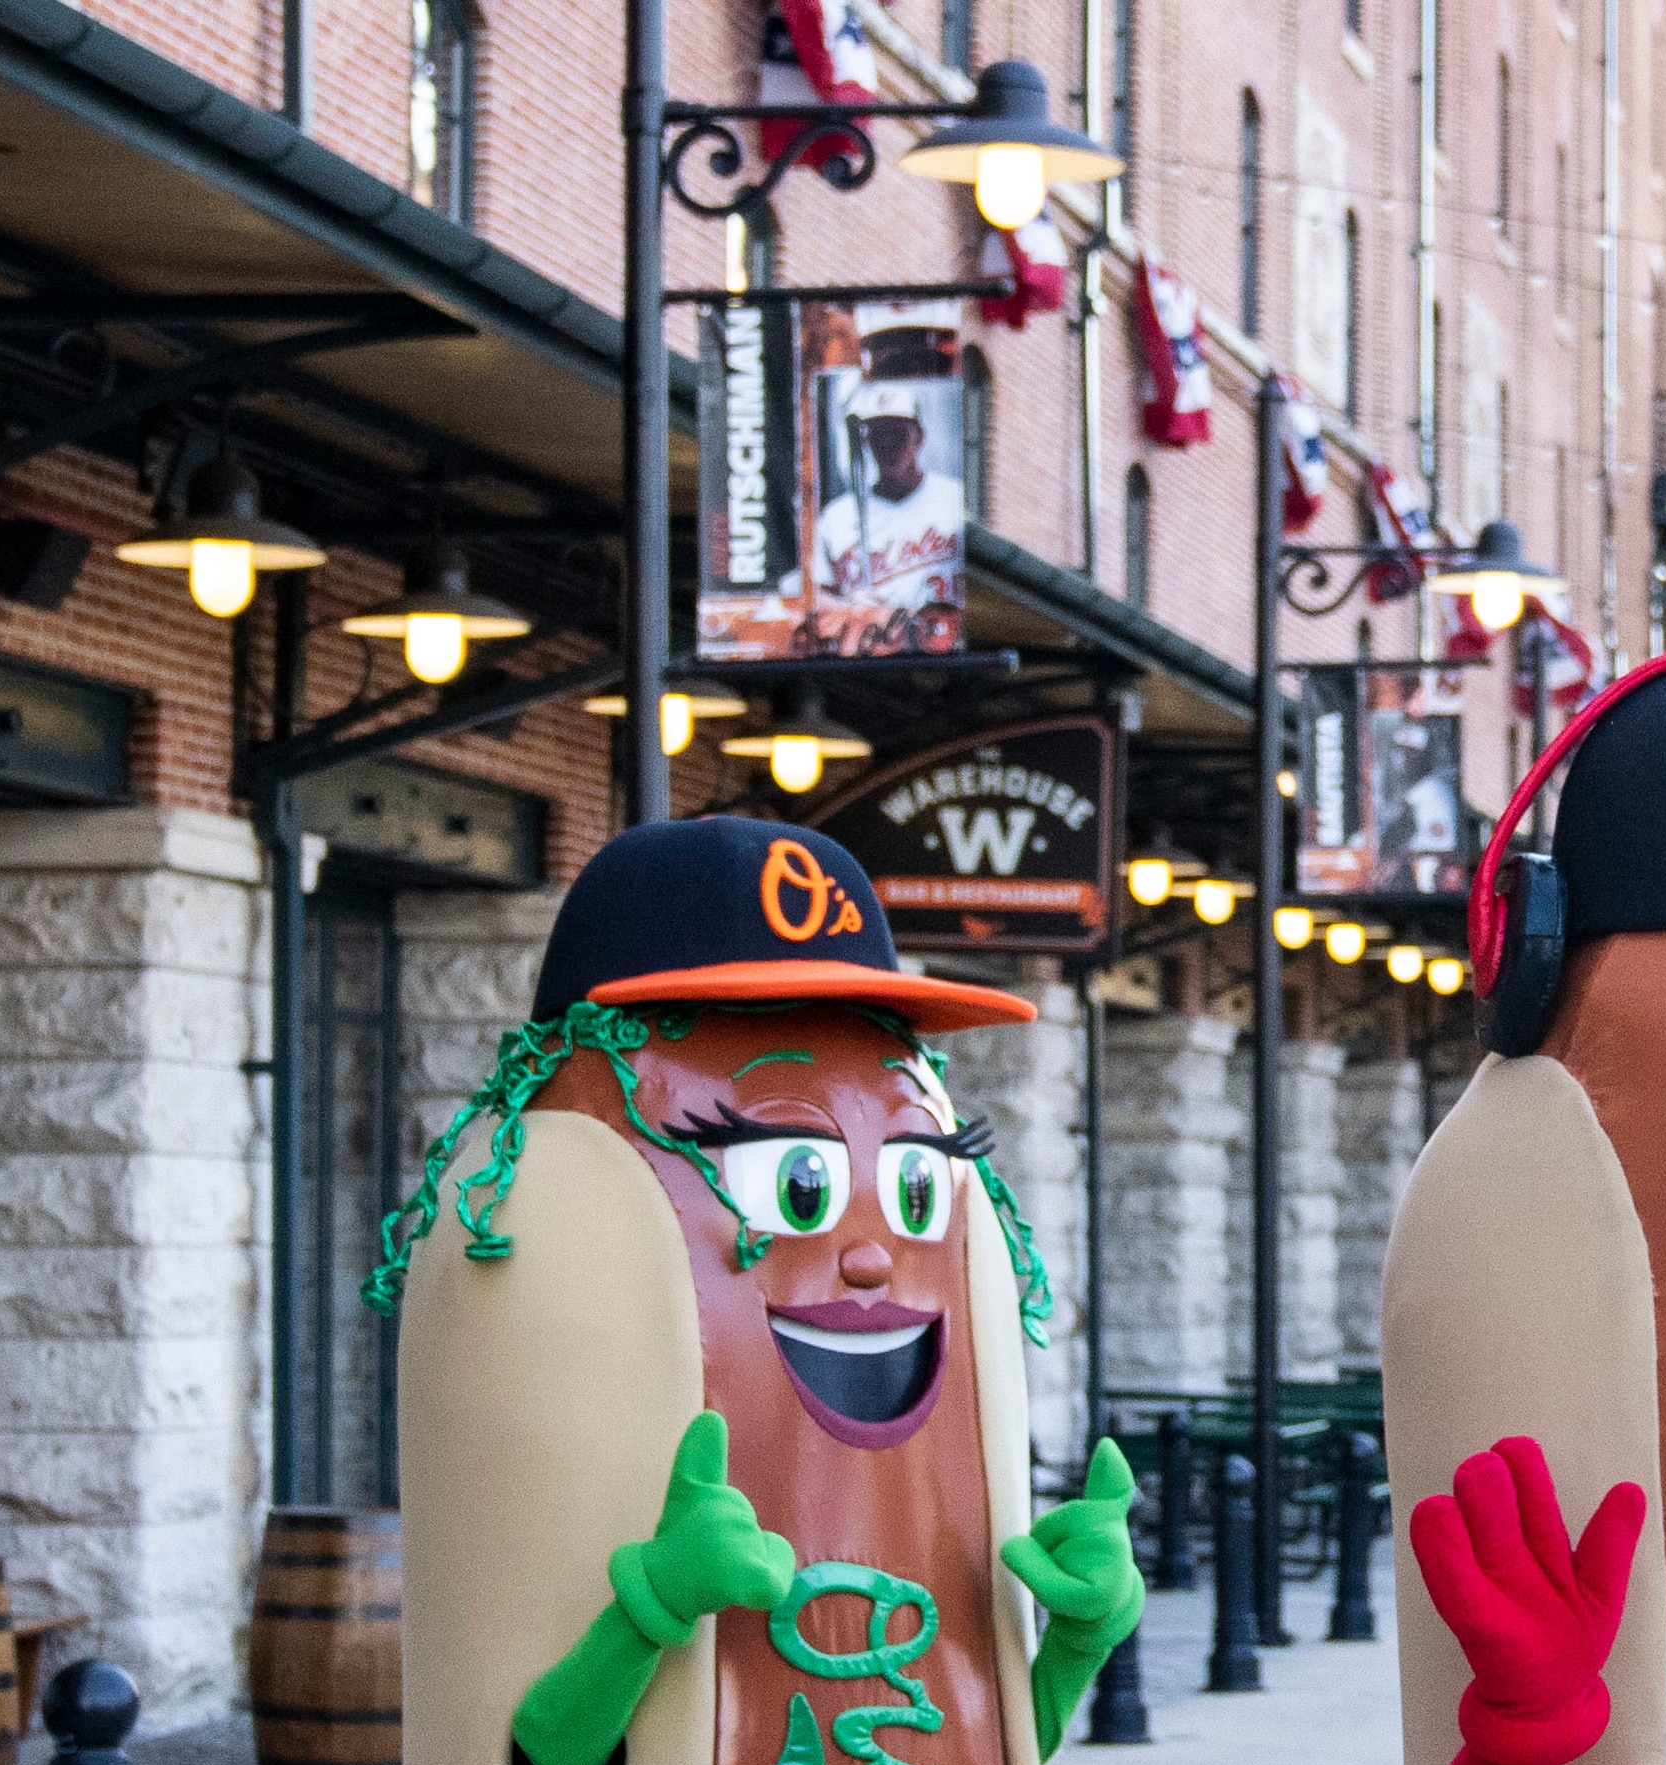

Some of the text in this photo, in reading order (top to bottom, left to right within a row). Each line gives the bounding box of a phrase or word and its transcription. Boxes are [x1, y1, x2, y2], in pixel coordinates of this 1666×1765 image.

[726, 306, 767, 583] RUTSCHMAN
[879, 762, 1096, 831] WAREHOUSE
[937, 805, 1036, 875] W
[759, 838, 864, 942] O's
